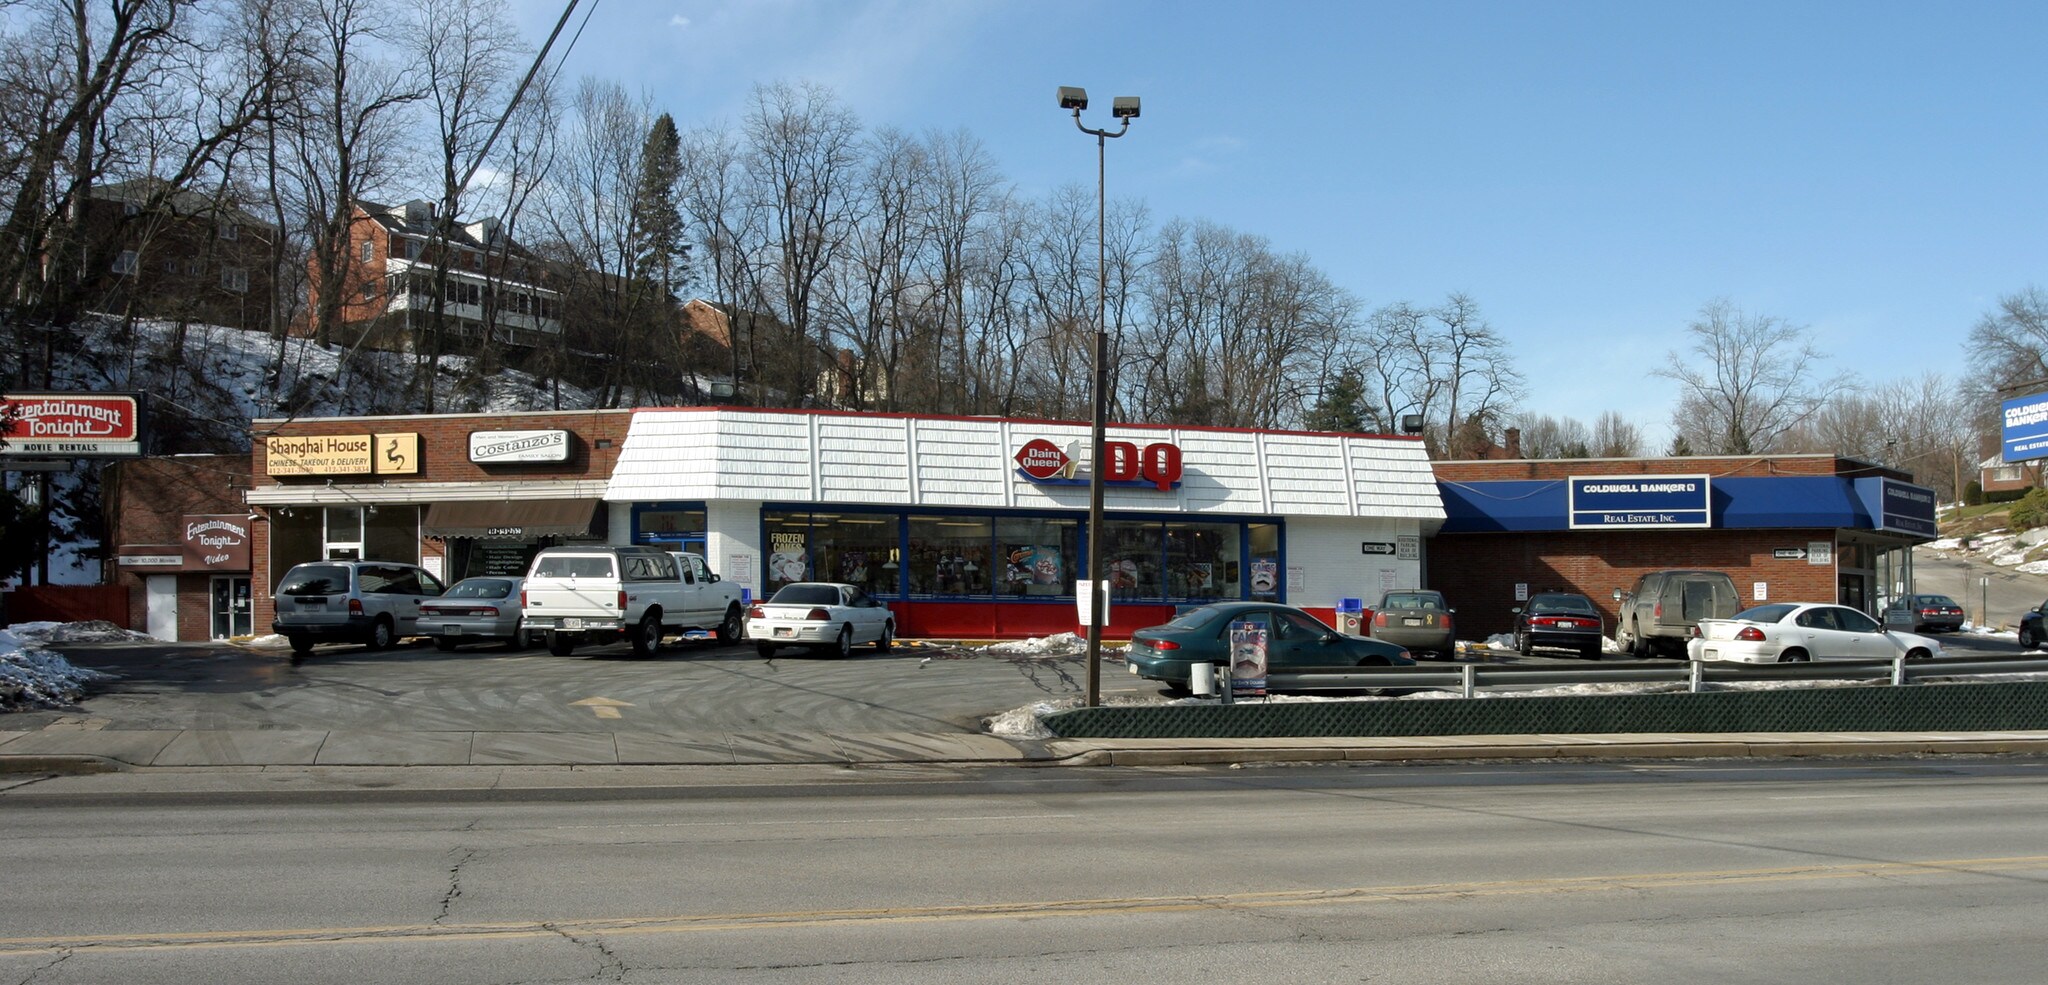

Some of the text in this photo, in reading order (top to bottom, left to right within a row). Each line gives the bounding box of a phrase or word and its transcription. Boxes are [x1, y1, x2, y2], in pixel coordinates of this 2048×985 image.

[0, 400, 123, 427] tertainment
[2005, 402, 2048, 418] COLDWE
[2006, 412, 2048, 428] BANKER
[25, 420, 113, 437] Tonight
[270, 438, 368, 457] Shanghai House
[475, 433, 562, 457] Costanzo's
[1028, 448, 1061, 460] Dairy
[269, 459, 299, 467] CHINESE
[300, 458, 329, 466] TAKEOUT
[336, 457, 368, 466] DELIVERY
[1023, 458, 1061, 468] Queen
[1104, 441, 1183, 492] DQ
[1583, 483, 1685, 493] COLDWELL BANKER
[1604, 515, 1626, 523] REAL
[187, 520, 246, 540] Entertainment
[199, 534, 240, 549] Tonight
[771, 533, 805, 543] FROZEN
[204, 554, 230, 565] Video
[1232, 632, 1267, 643] CAKES
